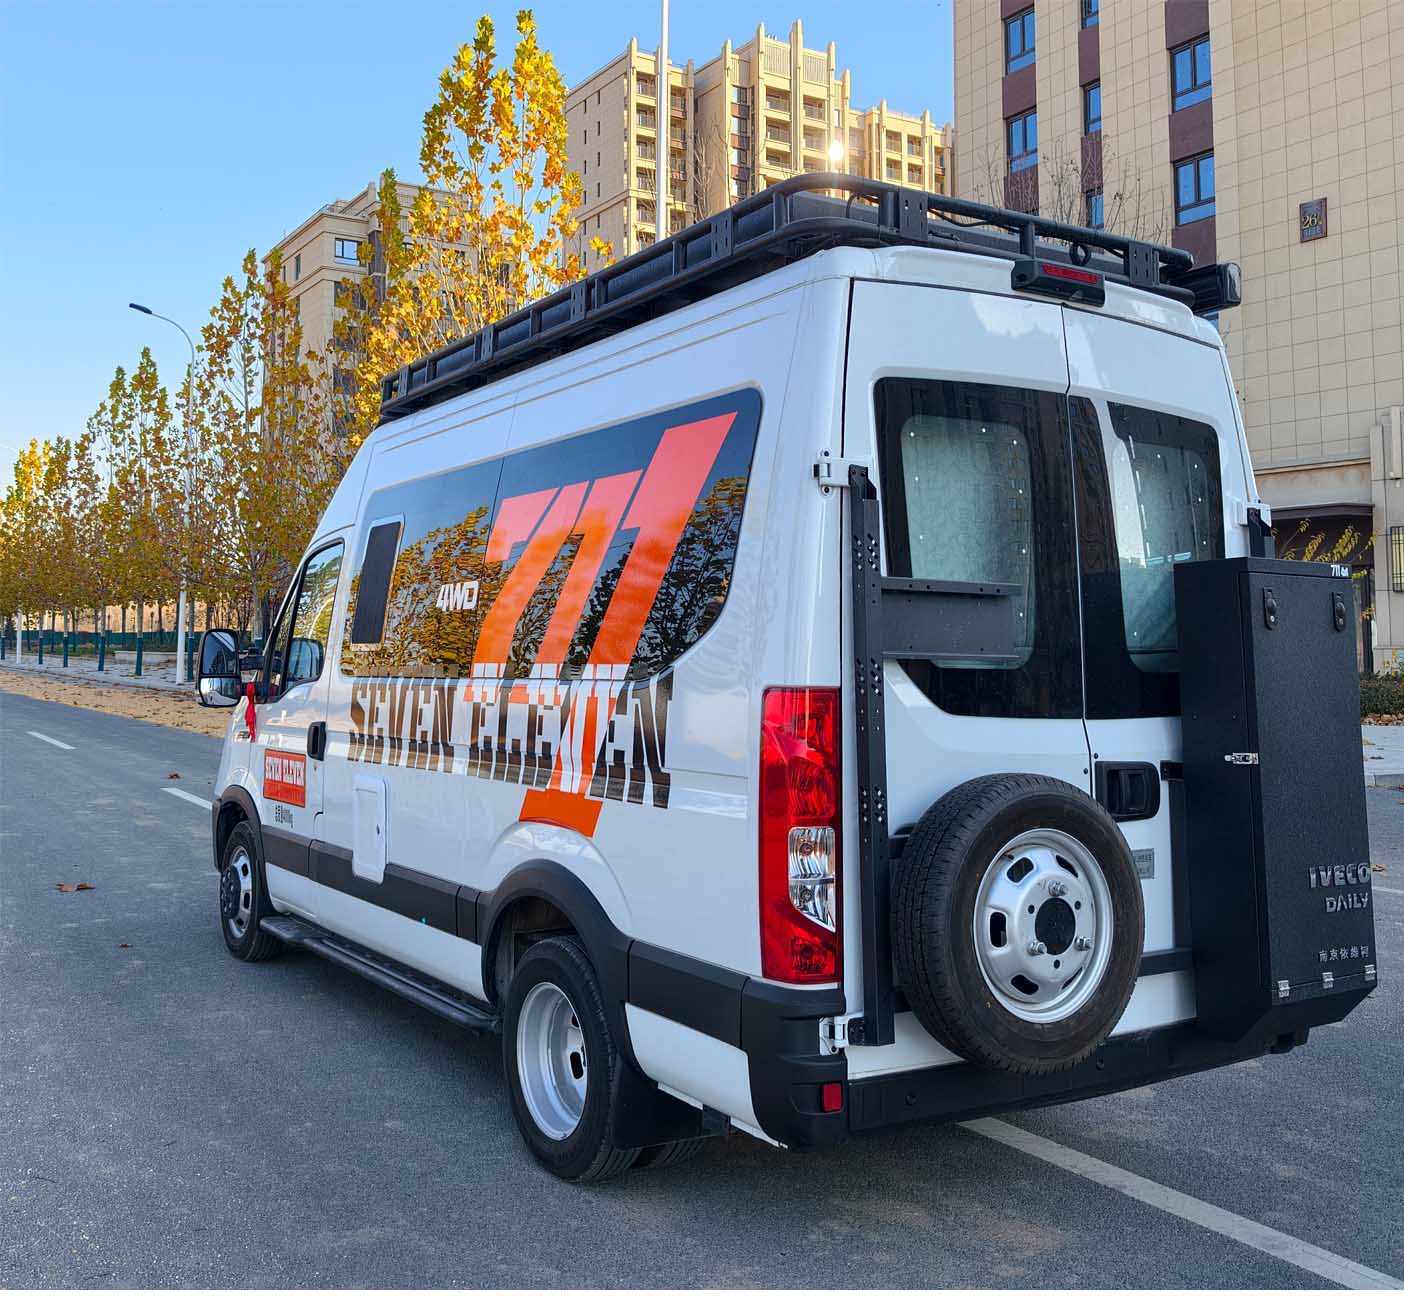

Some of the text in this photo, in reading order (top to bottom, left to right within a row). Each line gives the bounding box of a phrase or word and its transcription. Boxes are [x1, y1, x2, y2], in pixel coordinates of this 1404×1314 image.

[435, 580, 479, 612] 4WD
[346, 662, 675, 809] SEVEN ELEVEN
[1309, 863, 1371, 888] IVECO
[1325, 892, 1369, 913] DAILY
